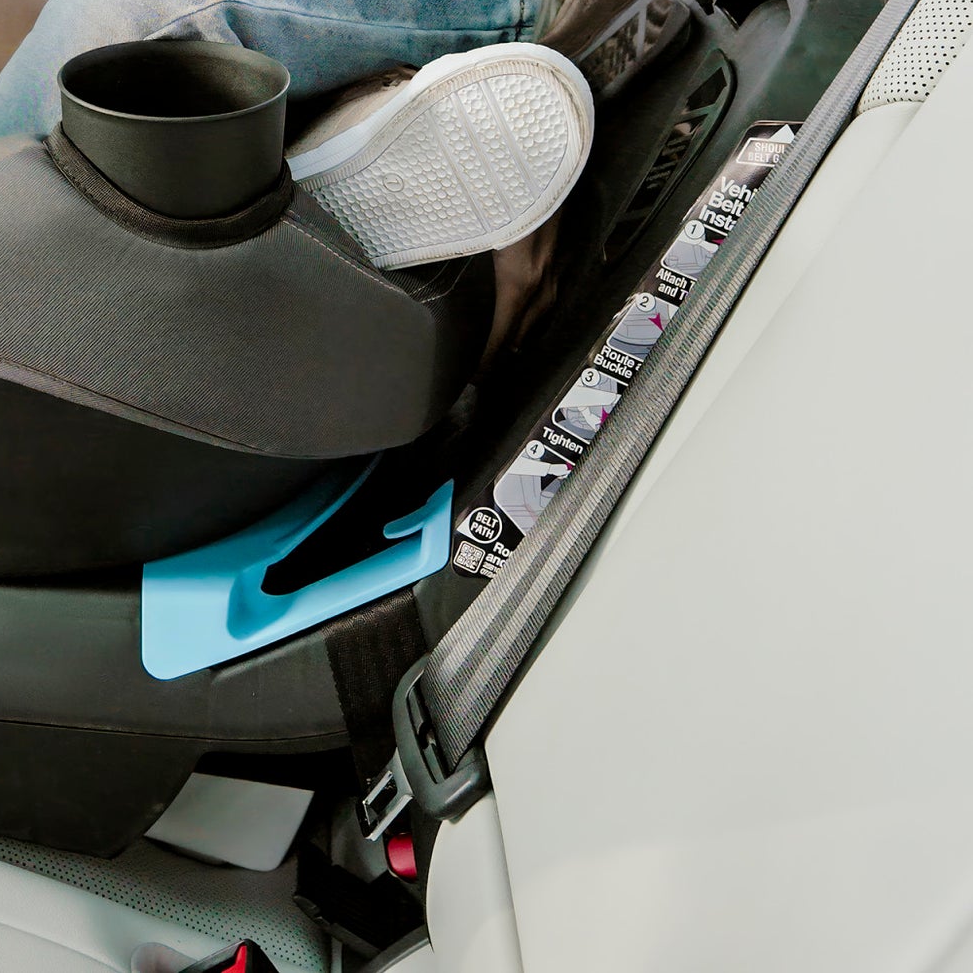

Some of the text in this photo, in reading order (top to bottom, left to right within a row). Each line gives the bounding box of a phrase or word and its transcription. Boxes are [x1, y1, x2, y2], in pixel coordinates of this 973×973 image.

[748, 152, 771, 163] BELT
[709, 190, 745, 217] Belt
[655, 268, 688, 289] Attach
[657, 283, 679, 298] and
[640, 295, 649, 308] 2
[601, 345, 635, 368] Route
[593, 353, 633, 379] Buckle
[584, 370, 594, 382] 3
[529, 443, 538, 455] 4
[542, 427, 584, 455] Tighten
[475, 512, 499, 529] BELT
[470, 521, 495, 539] PATH
[493, 542, 513, 558] Ro
